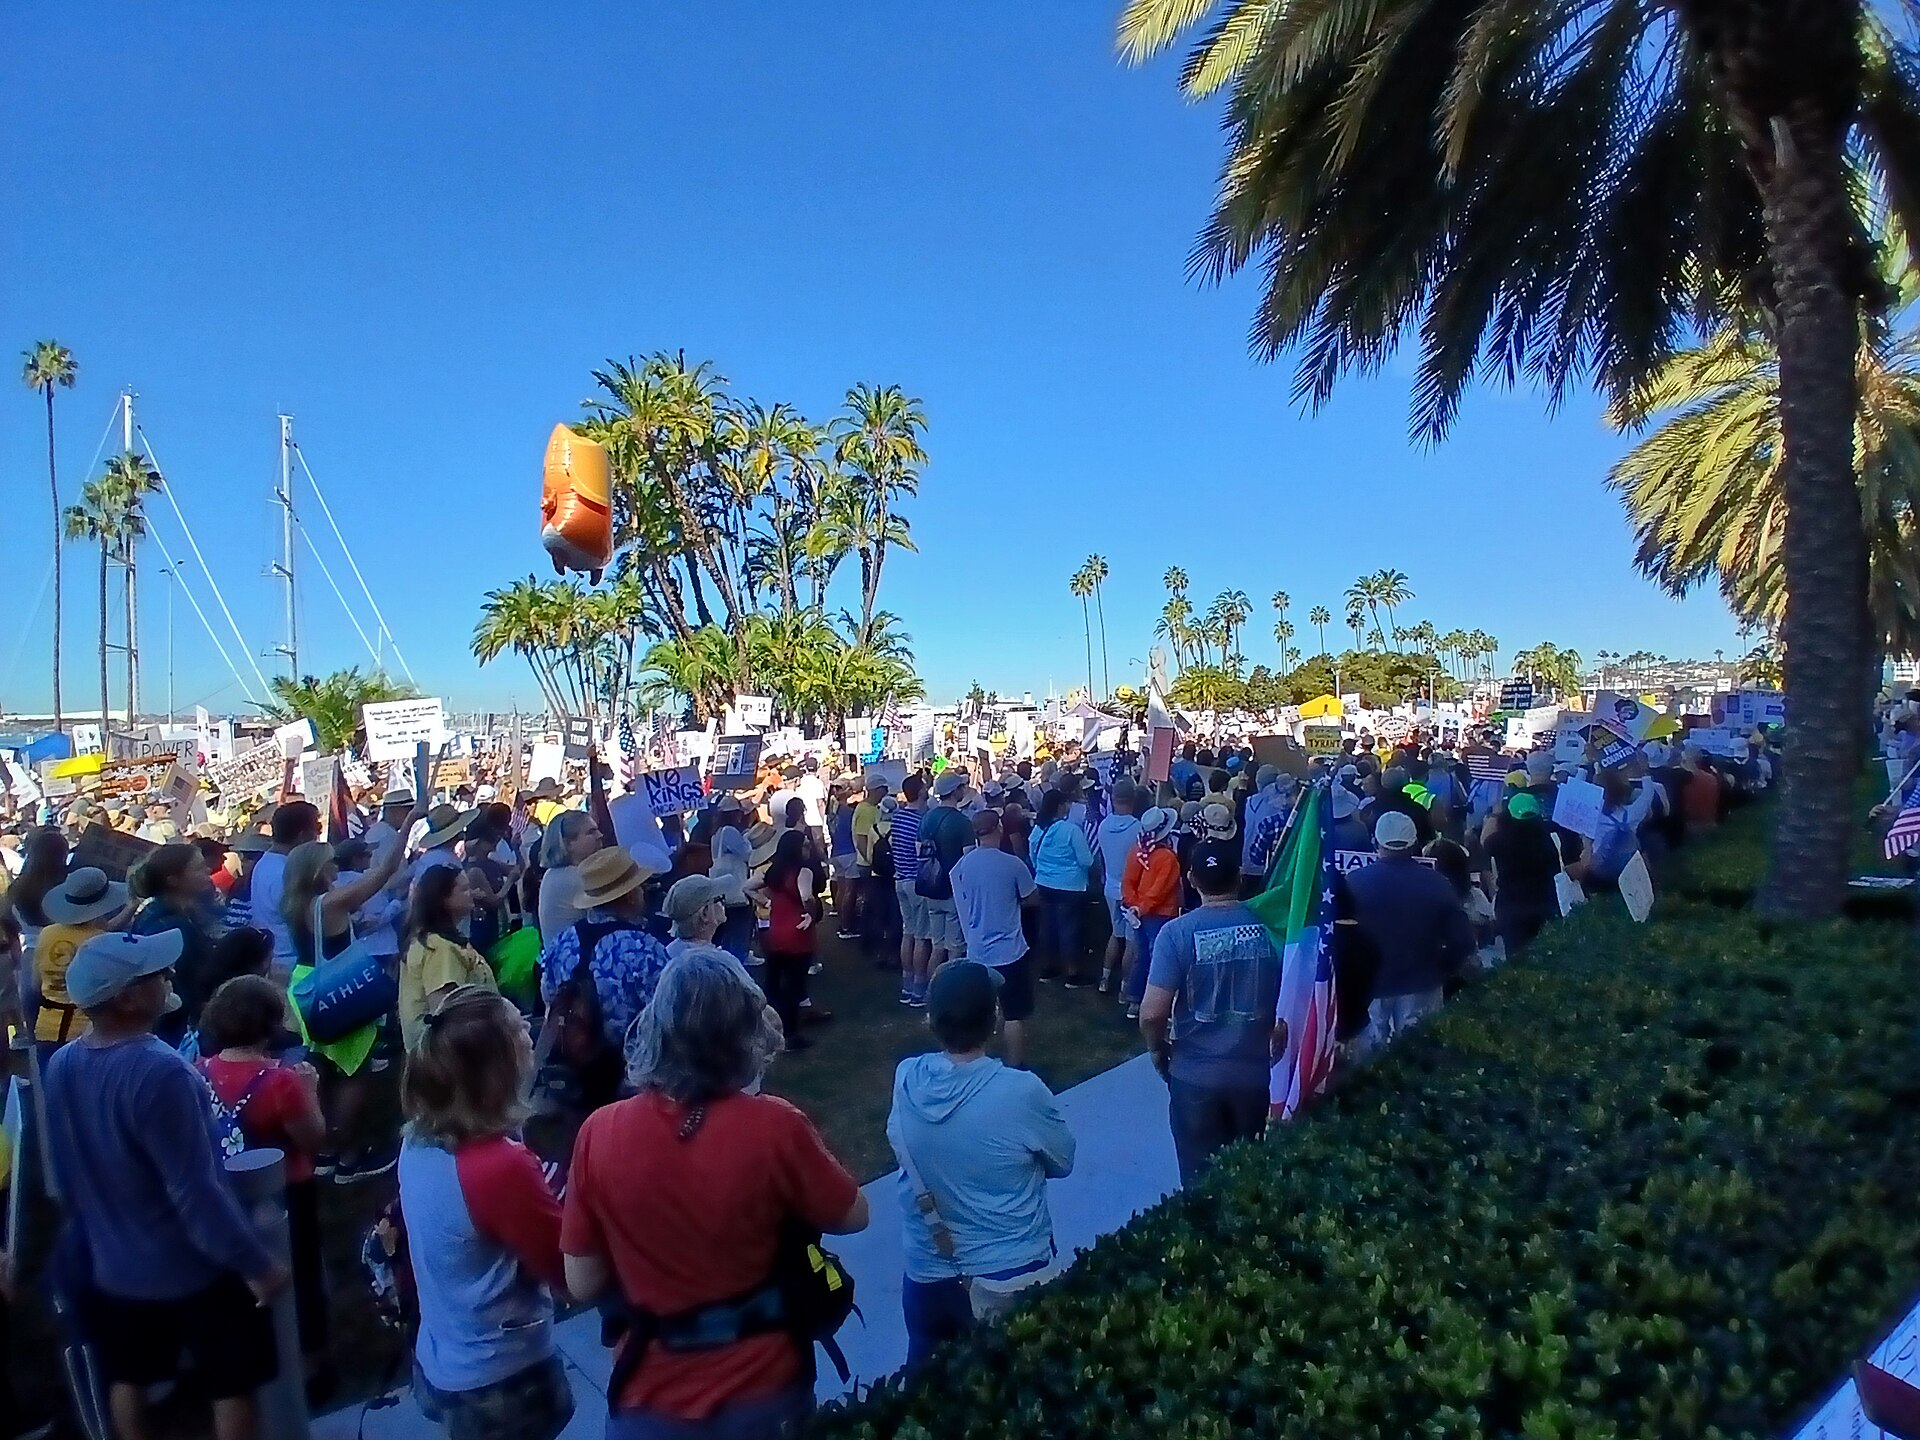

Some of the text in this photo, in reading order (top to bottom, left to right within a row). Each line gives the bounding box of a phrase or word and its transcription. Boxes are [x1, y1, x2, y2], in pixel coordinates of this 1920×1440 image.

[142, 740, 194, 758] POWER
[1309, 739, 1340, 748] TYRANT
[1603, 741, 1621, 756] FREE
